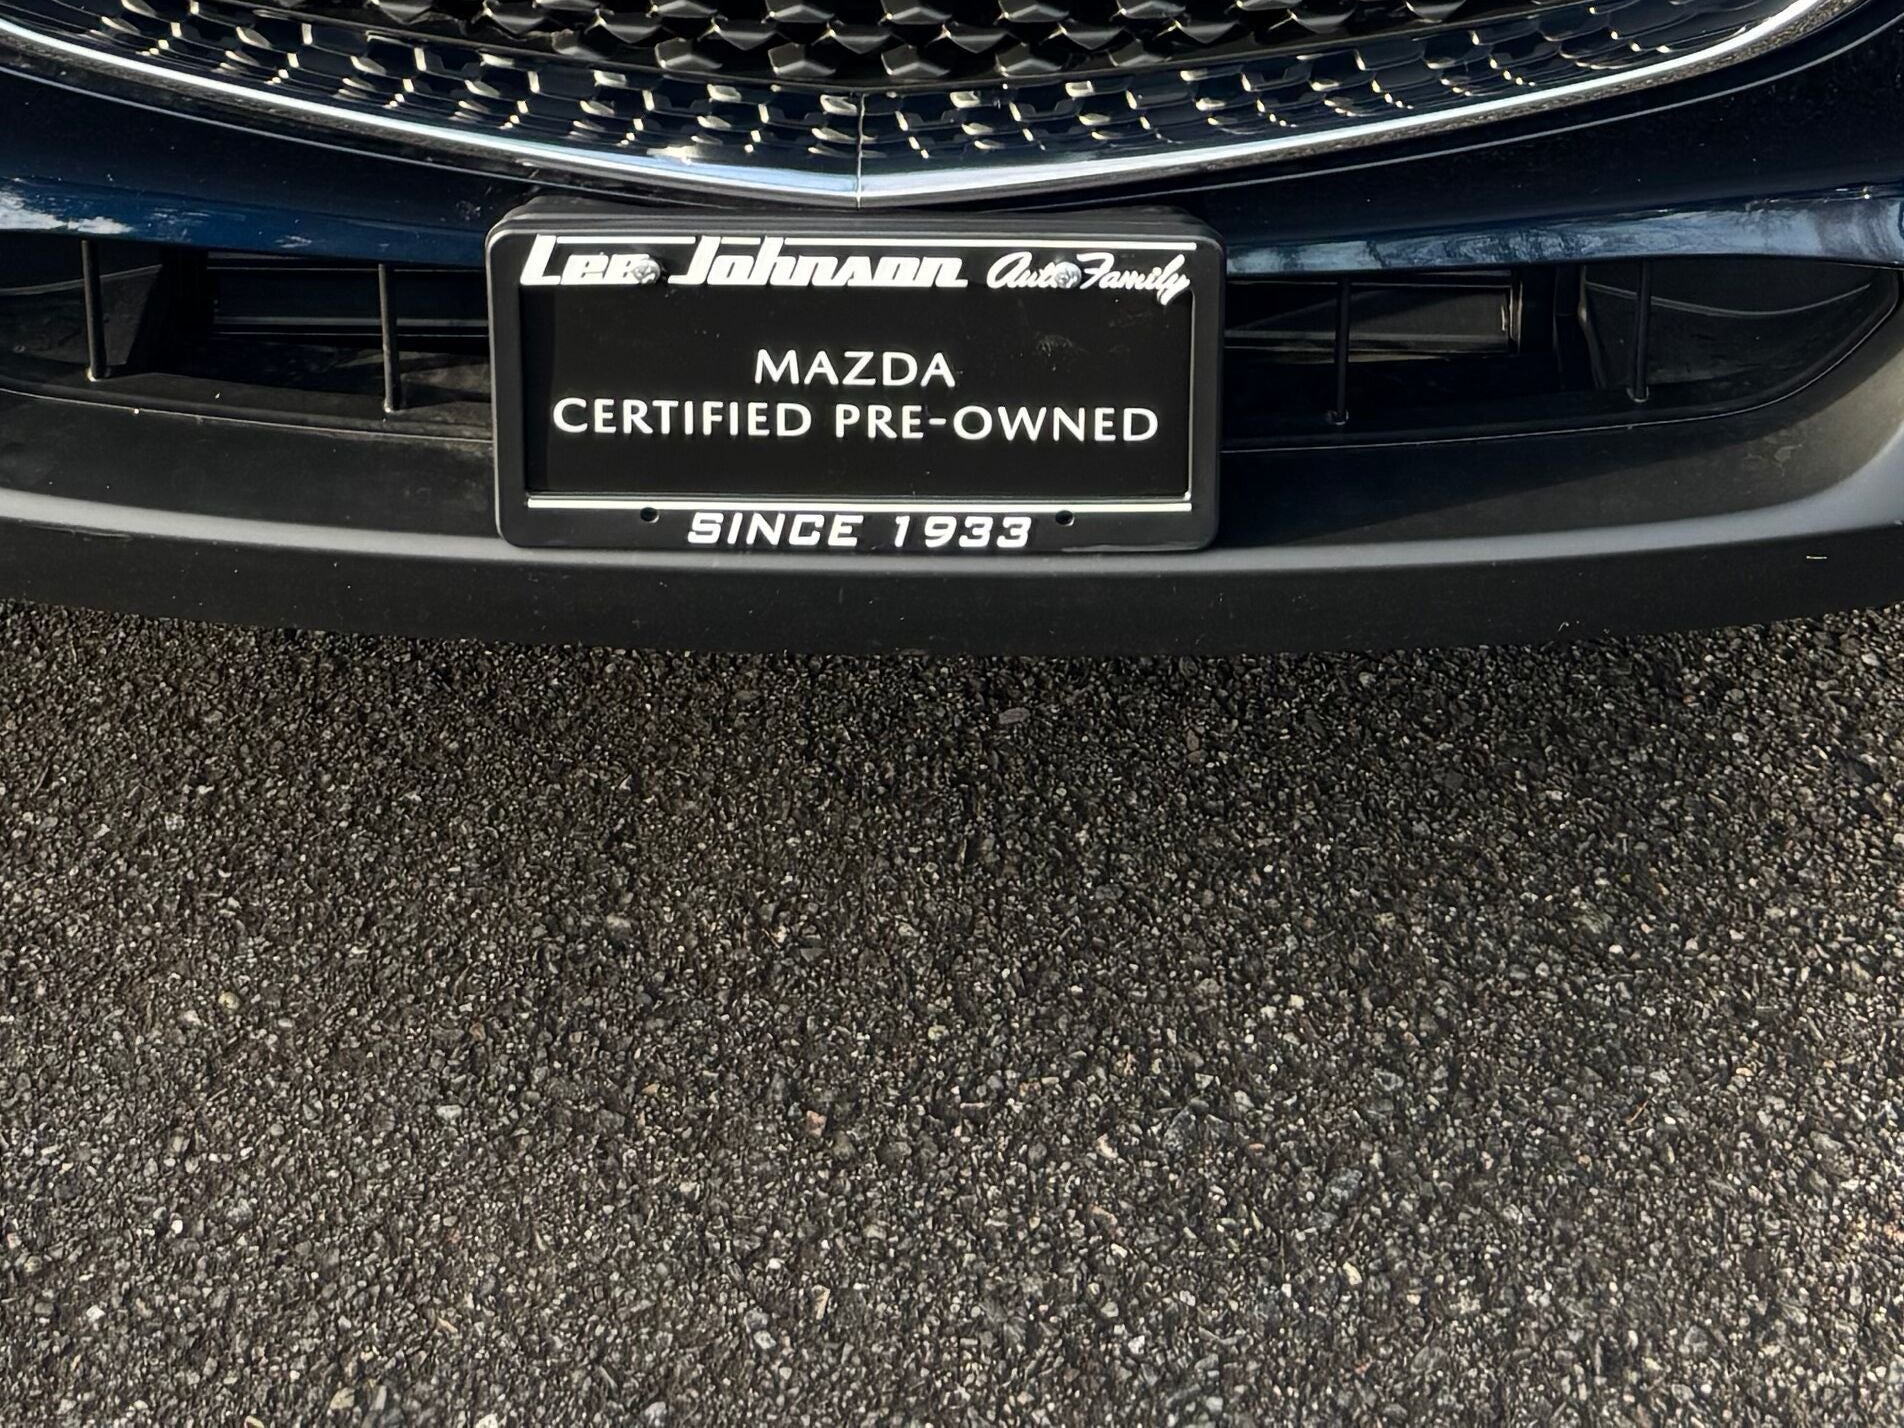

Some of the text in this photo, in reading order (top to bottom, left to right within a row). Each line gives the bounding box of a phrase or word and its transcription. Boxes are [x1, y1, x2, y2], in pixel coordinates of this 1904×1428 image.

[668, 235, 968, 287] Johnson
[987, 251, 1081, 289] Aut
[1076, 252, 1190, 305] Family
[755, 349, 956, 387] MAZDA
[552, 397, 1159, 442] CERTIFIED PRE-OWNED
[687, 511, 1032, 548] SINCE 1933
